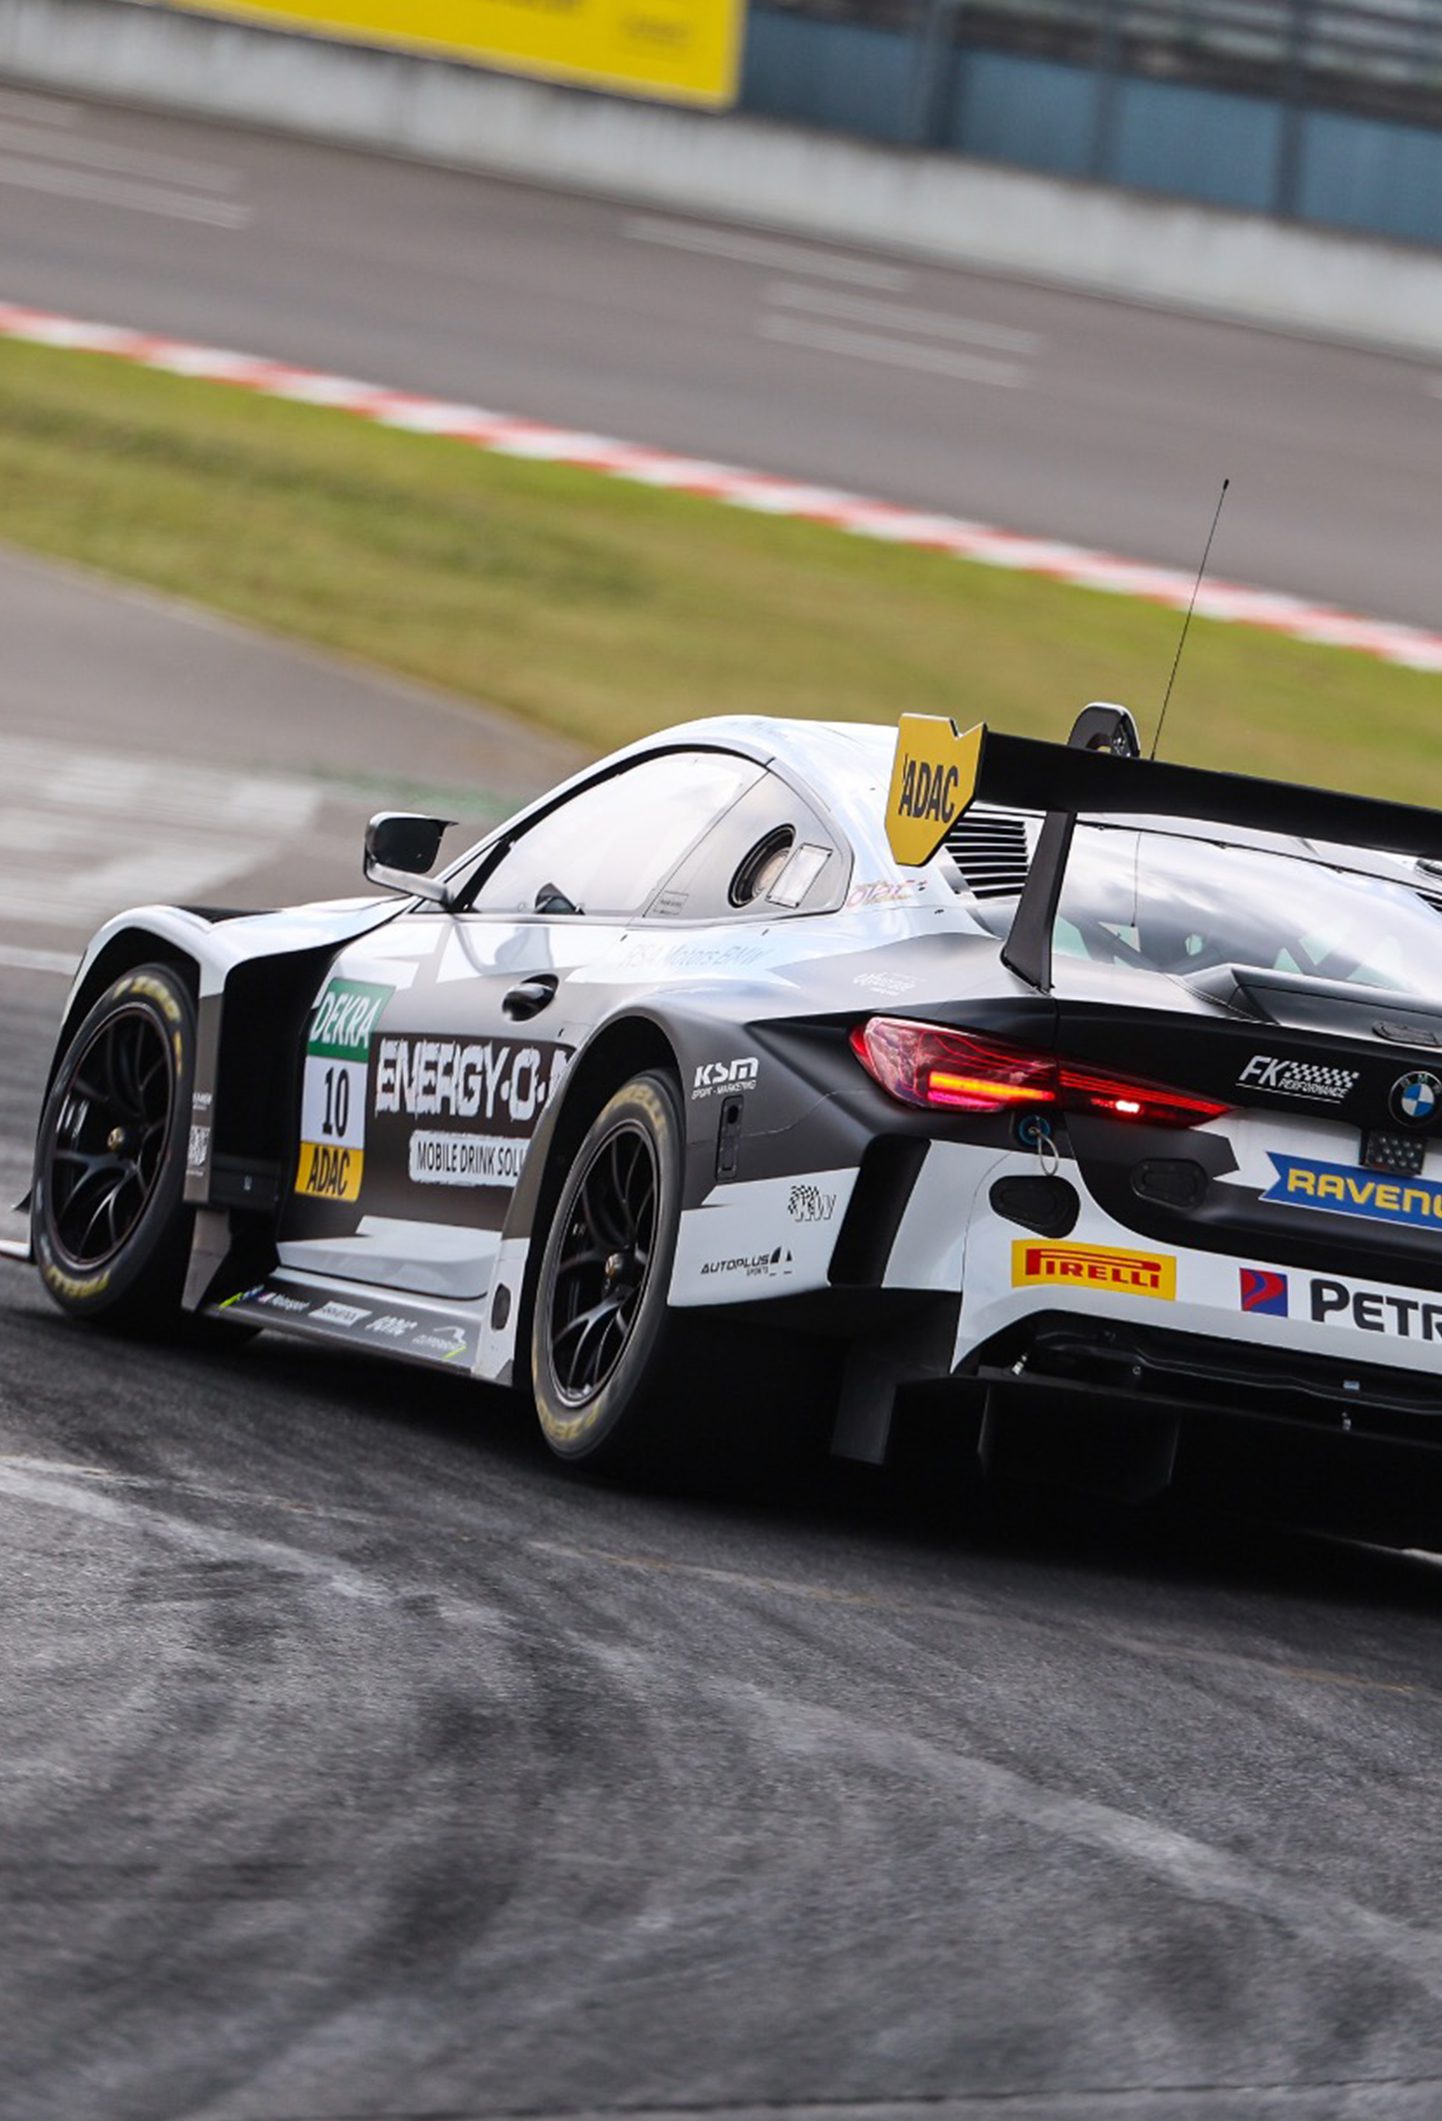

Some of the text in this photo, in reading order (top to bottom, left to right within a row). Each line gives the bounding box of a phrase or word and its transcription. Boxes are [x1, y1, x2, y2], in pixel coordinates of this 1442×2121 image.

[899, 755, 959, 824] ADAC
[311, 991, 382, 1049] DEKRA
[694, 1057, 759, 1088] KSM
[1239, 1055, 1290, 1087] FK
[1278, 1078, 1349, 1099] PERFORMANCE
[322, 1066, 349, 1138] 10
[306, 1148, 349, 1196] ADAC
[417, 1141, 457, 1172] MOBILE
[460, 1145, 496, 1175] DRINK
[700, 1253, 770, 1275] AUTOPLUS
[1026, 1249, 1162, 1289] PIRELLI
